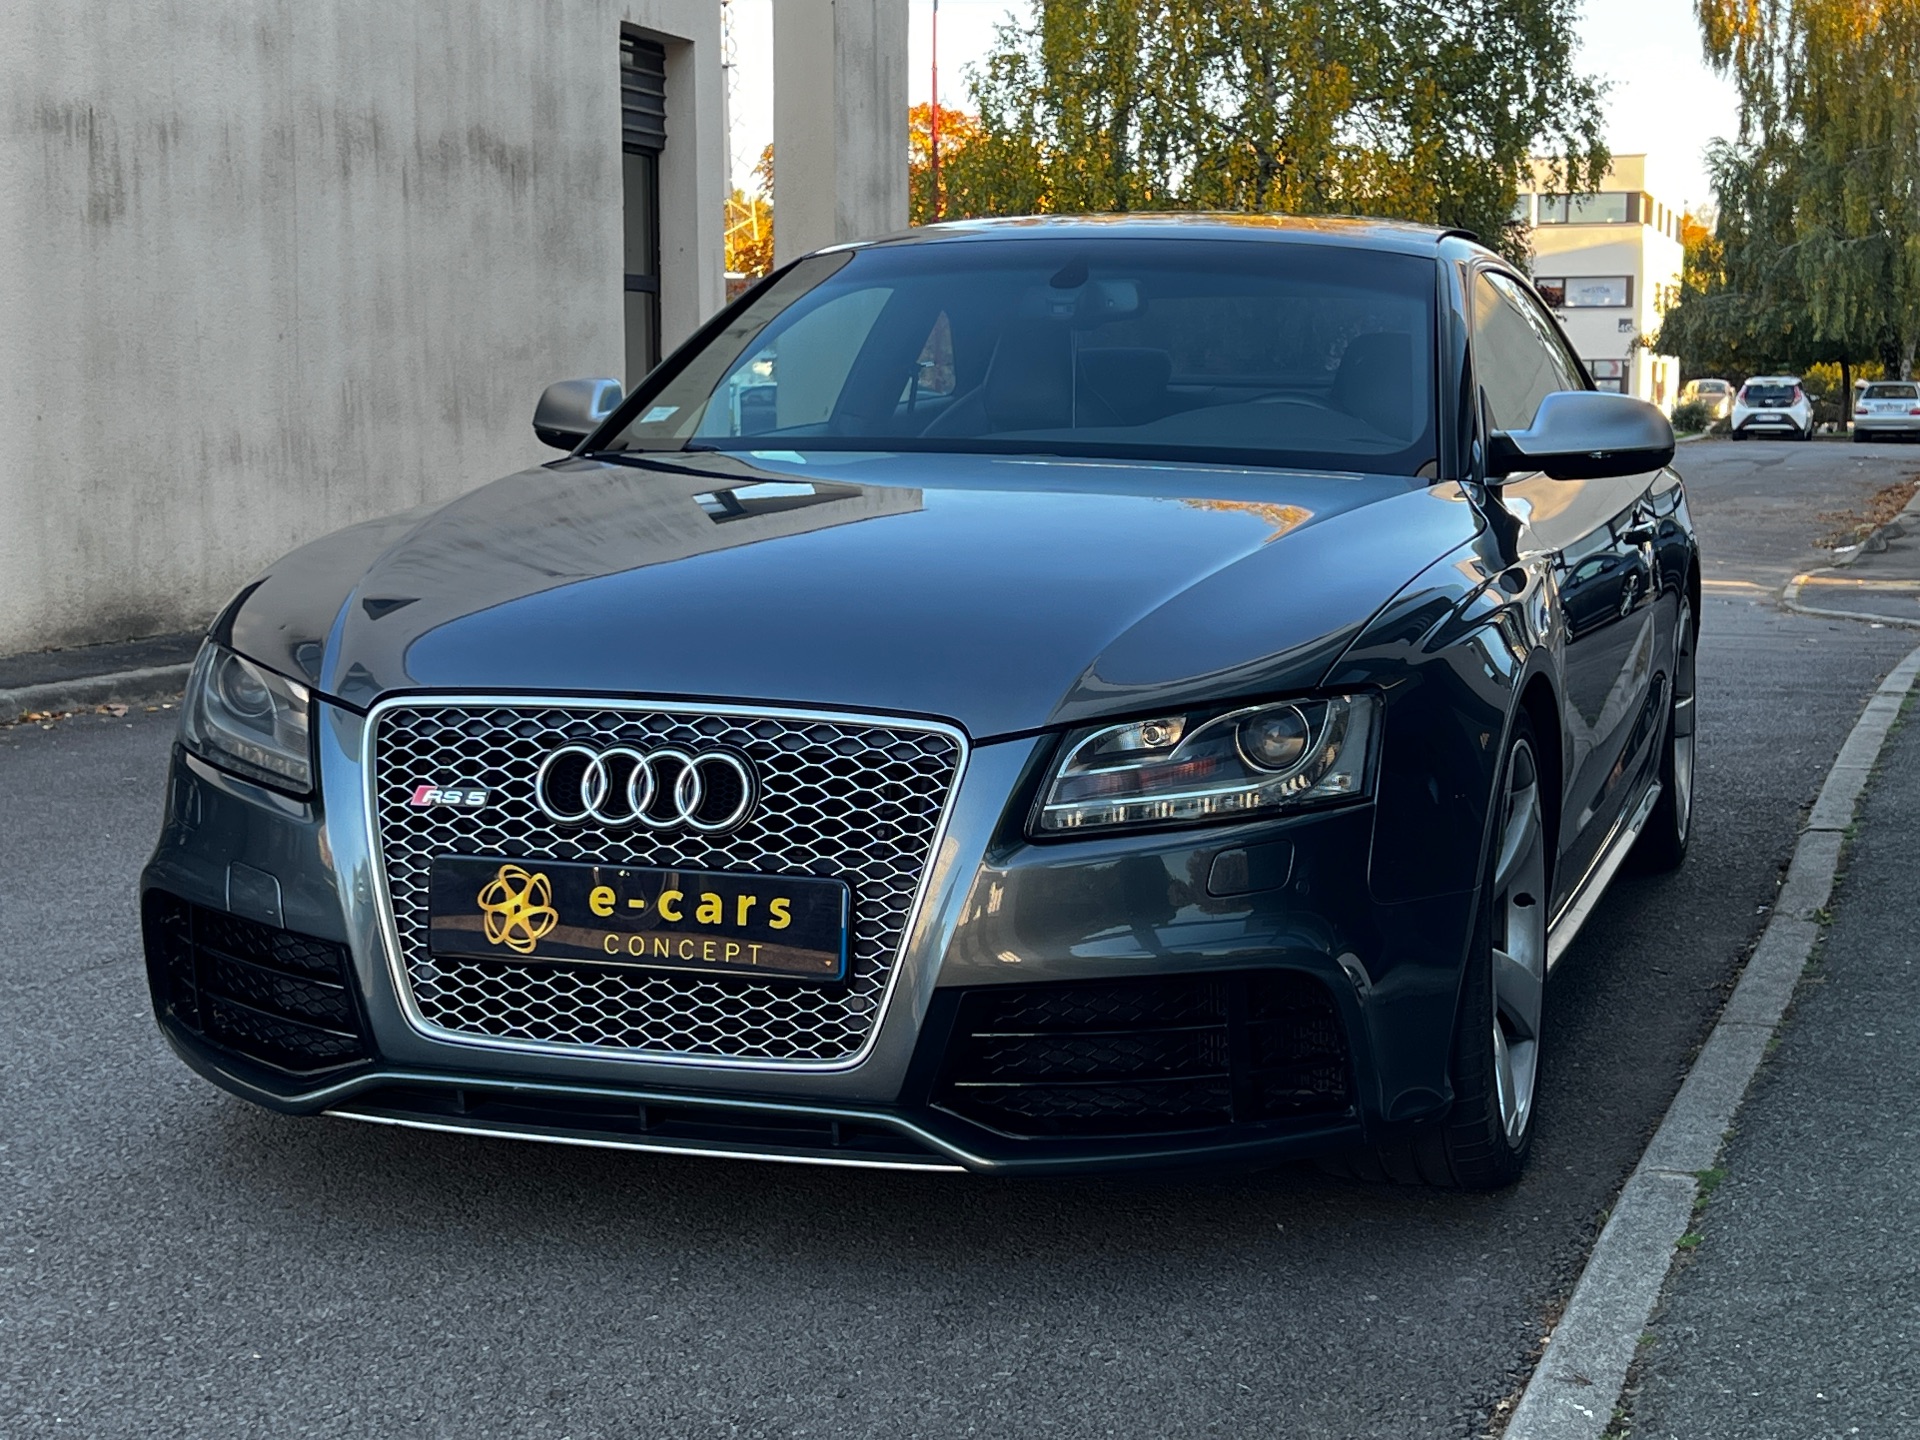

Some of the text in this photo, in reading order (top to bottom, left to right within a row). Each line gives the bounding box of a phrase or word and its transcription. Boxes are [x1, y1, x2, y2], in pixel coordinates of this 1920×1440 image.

[422, 789, 463, 804] RS
[589, 886, 792, 930] e-cars
[604, 934, 763, 965] CONCEPT
